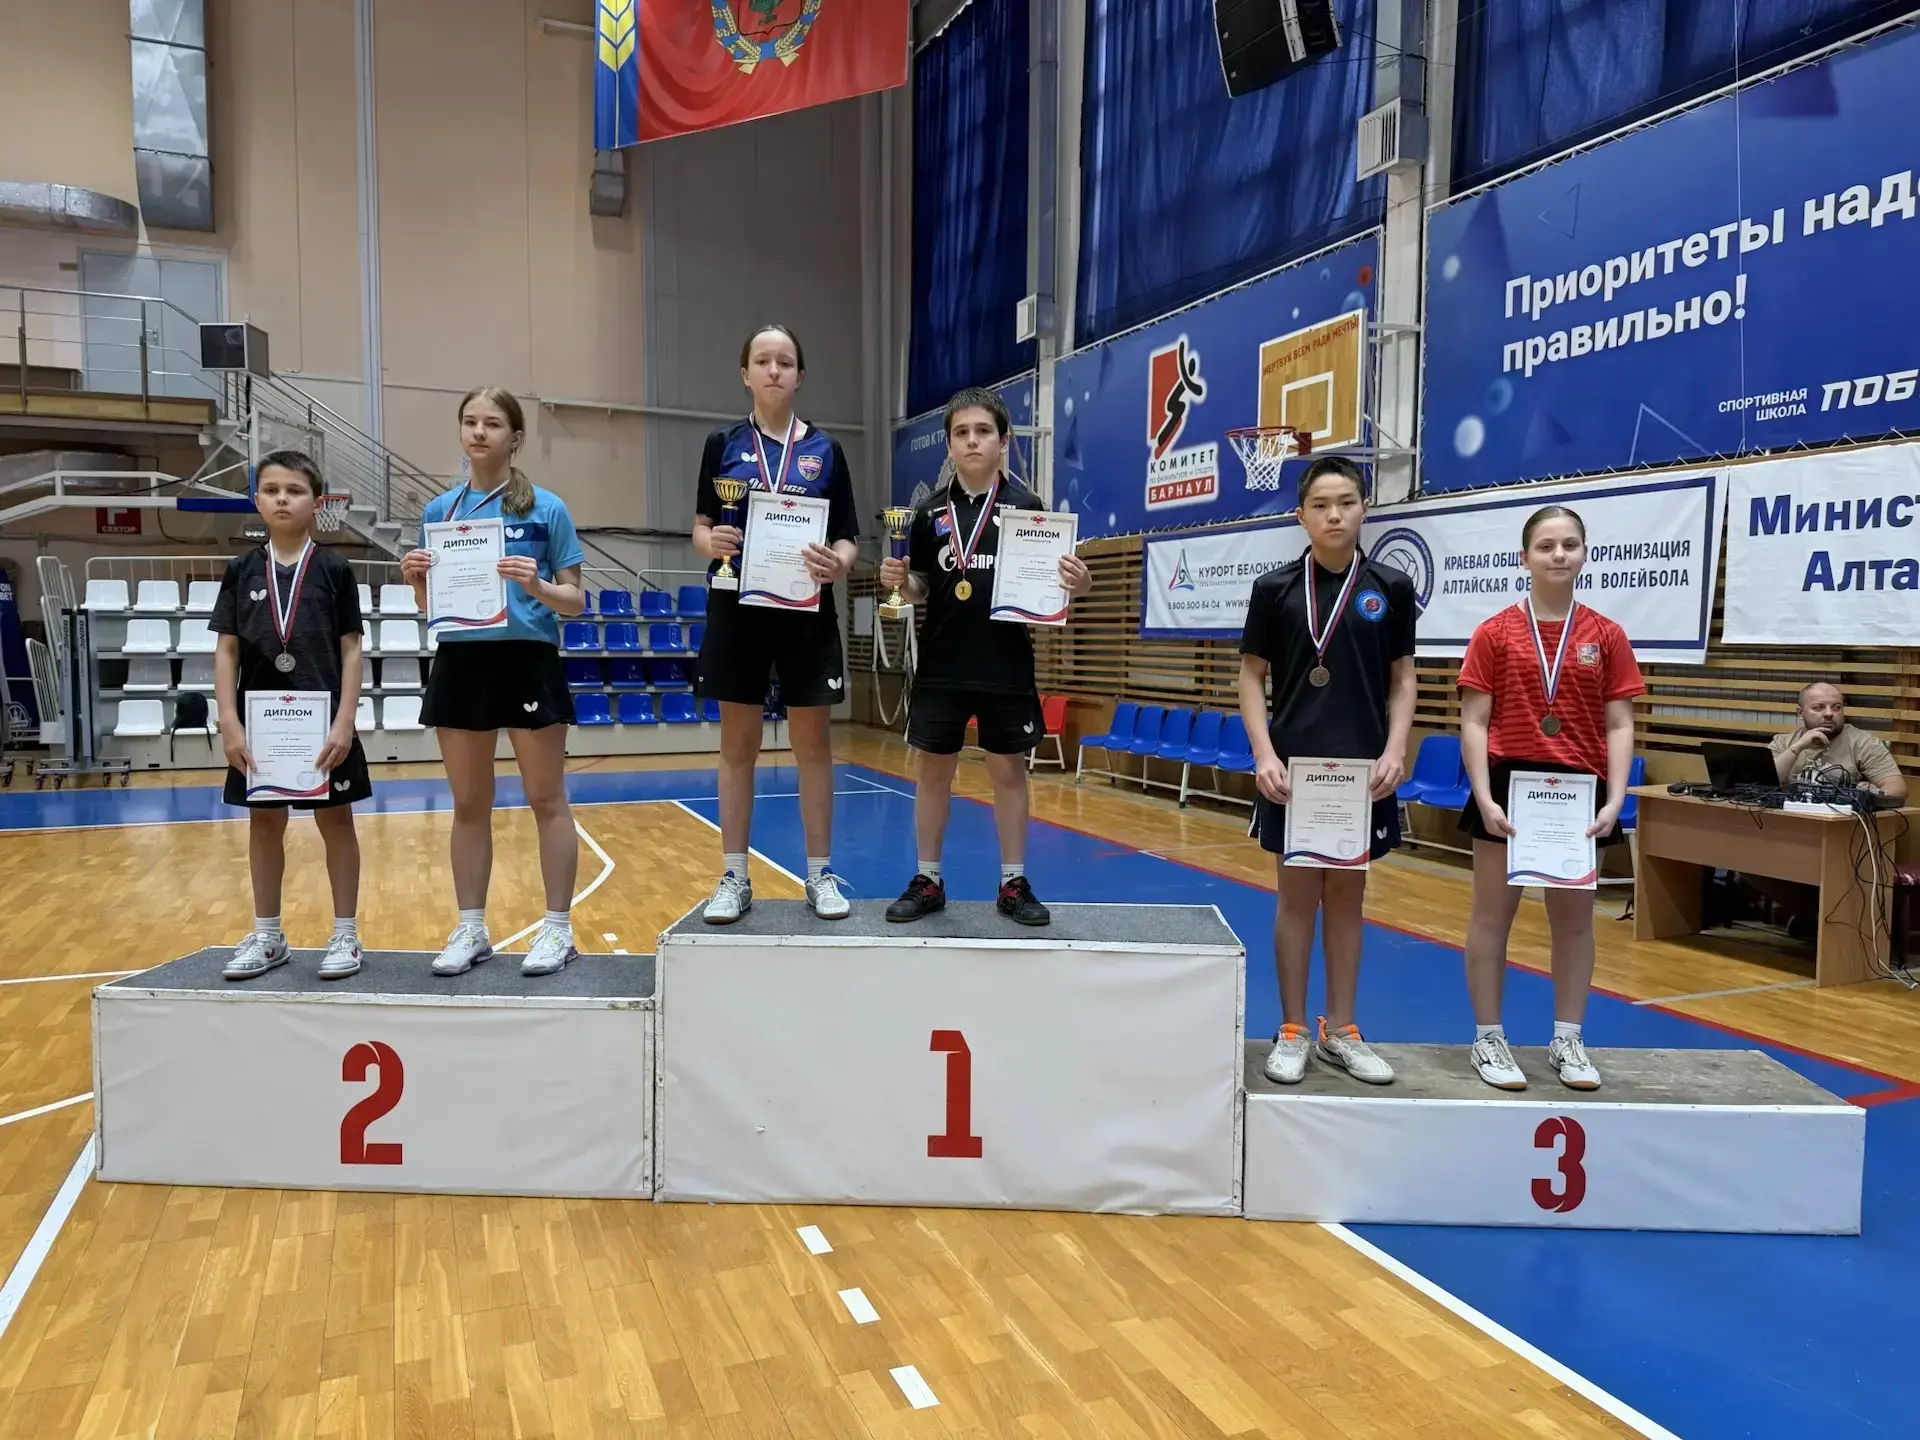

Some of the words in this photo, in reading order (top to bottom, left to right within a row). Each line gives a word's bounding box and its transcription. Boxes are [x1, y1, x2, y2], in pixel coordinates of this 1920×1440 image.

[1503, 207, 1785, 321] Приоритеты
[1803, 168, 1920, 236] над
[1502, 273, 1748, 378] правильно!
[1293, 343, 1311, 361] ВСЕМ
[1718, 387, 1808, 413] СПОРТИВНАЯ
[1756, 403, 1807, 422] ШКОЛА
[910, 433, 931, 453] ГОТОВ
[1150, 448, 1214, 474] КОМИТЕТ
[1150, 478, 1213, 501] БАРНАУЛ
[764, 511, 811, 525] ДИПЛОМ
[1749, 494, 1920, 537] Минис
[442, 536, 489, 550] ДИПЛОМ
[1015, 527, 1060, 540] ДИПЛОМ
[1444, 553, 1490, 571] КРАЕВАЯ
[1591, 539, 1691, 562] ОРГАНИЗАЦИЯ
[1198, 564, 1235, 578] КУРОРТ
[1237, 560, 1295, 576] БЕЛОКУР
[1442, 576, 1509, 595] АЛТАЙСКАЯ
[1601, 567, 1690, 589] ВОЛЕЙБОЛА
[1801, 550, 1920, 592] Алта
[263, 708, 313, 718] ДИПЛОМ
[1305, 773, 1356, 783] ДИПЛОМ
[1527, 790, 1577, 801] ДИПЛОМ
[340, 1040, 404, 1165] 2
[927, 1029, 983, 1159] 1
[1531, 1115, 1586, 1214] 3
